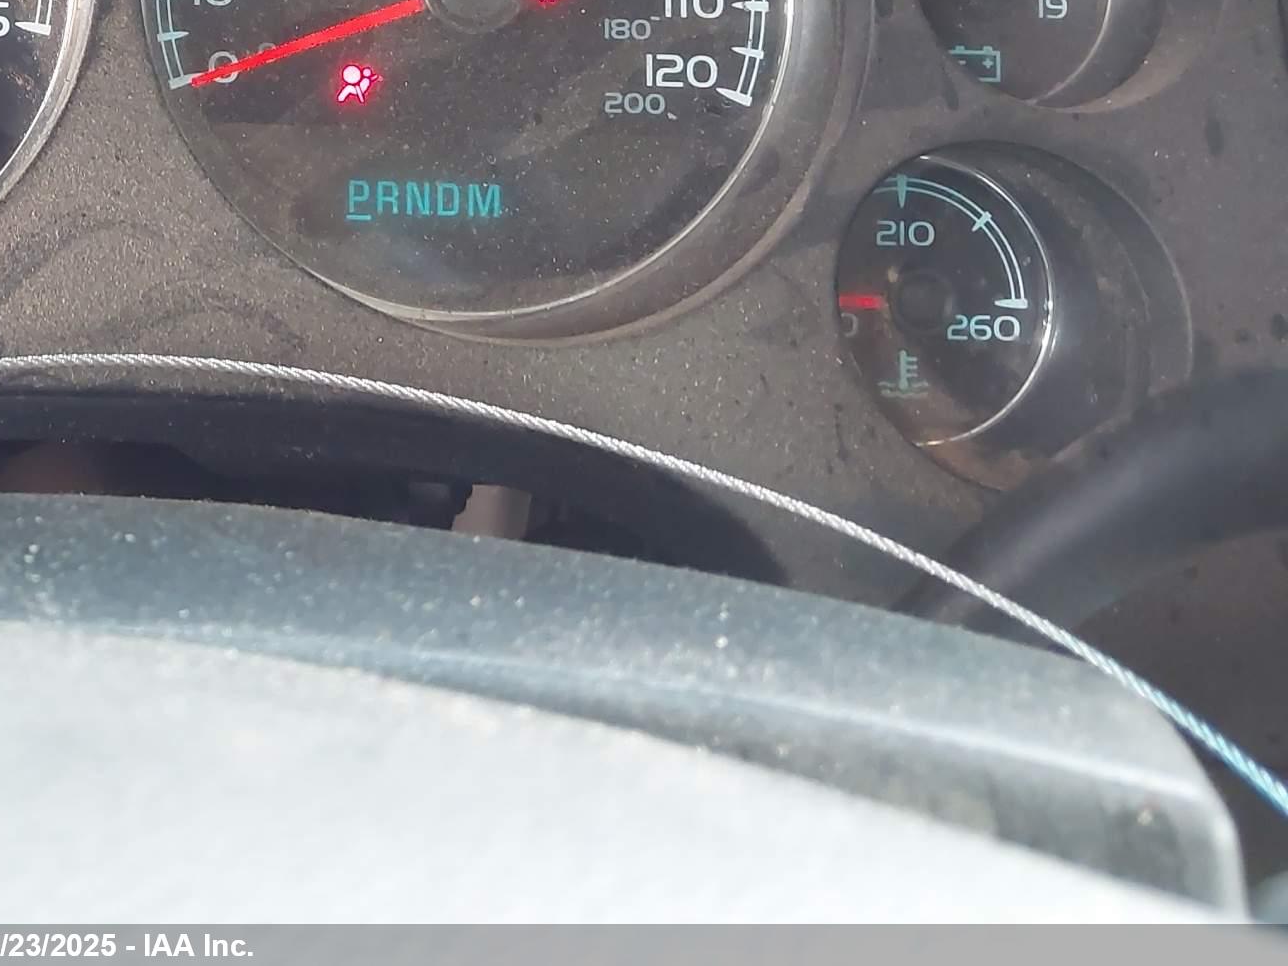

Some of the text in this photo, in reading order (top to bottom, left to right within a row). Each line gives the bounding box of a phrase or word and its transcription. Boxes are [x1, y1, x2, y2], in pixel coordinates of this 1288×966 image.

[603, 18, 651, 41] 180
[645, 54, 718, 88] 120
[603, 93, 665, 114] 200
[346, 180, 502, 220] PRNDM
[876, 220, 935, 246] 210
[947, 315, 1020, 341] 260
